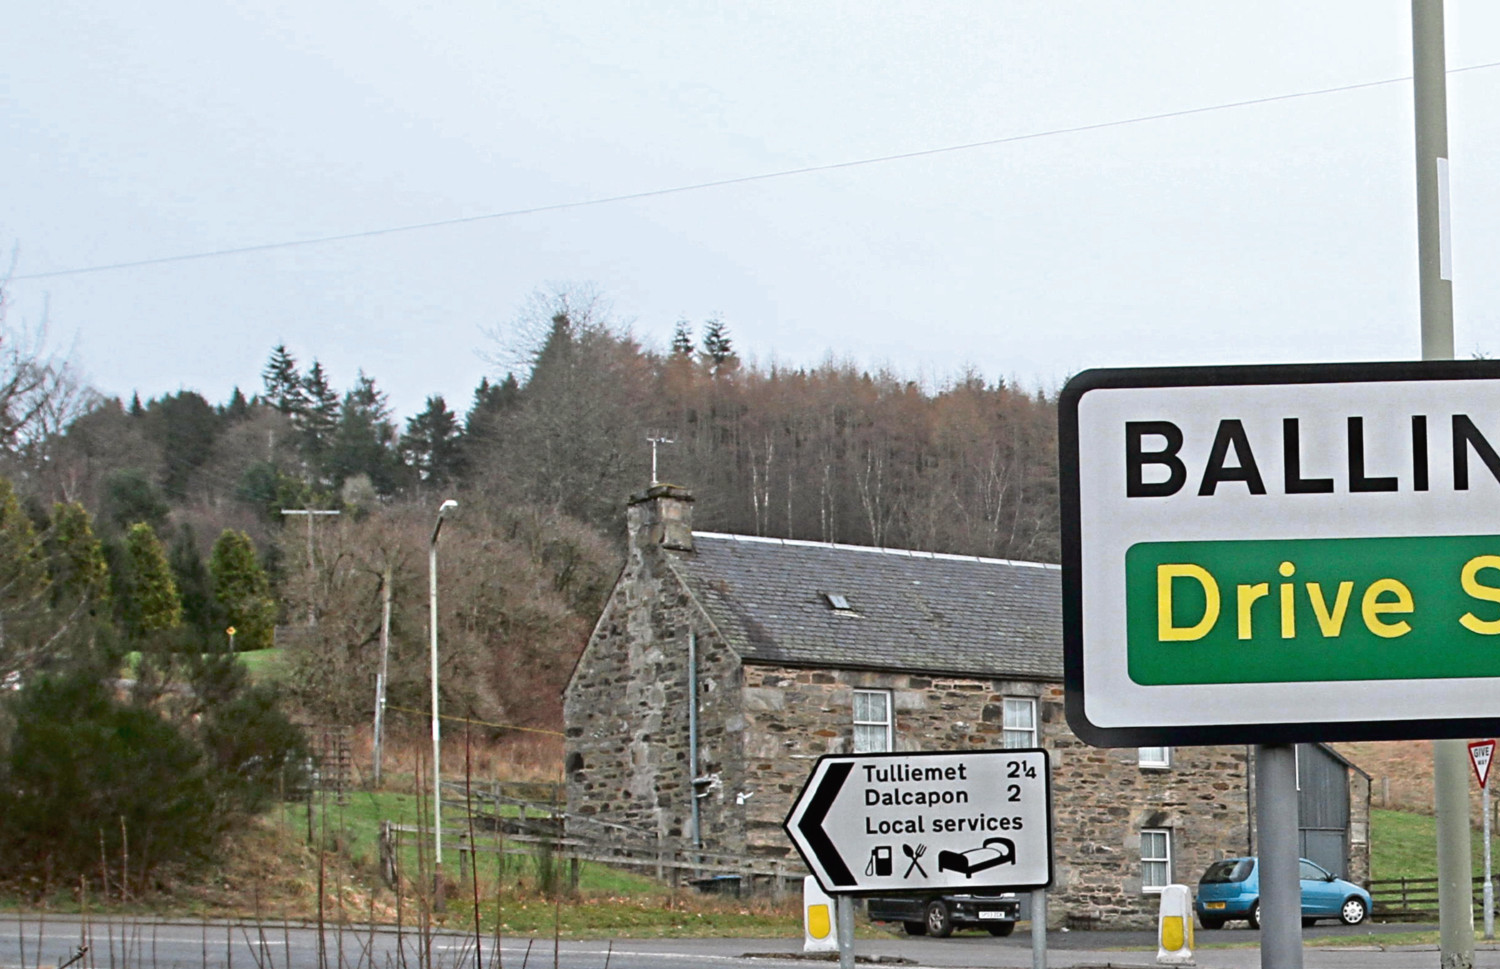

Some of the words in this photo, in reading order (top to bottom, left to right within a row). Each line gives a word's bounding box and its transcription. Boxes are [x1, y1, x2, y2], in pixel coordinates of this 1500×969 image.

[1158, 562, 1413, 641] Drive
[1474, 747, 1490, 758] GIVE
[863, 764, 966, 782] Tulliemet
[866, 788, 968, 807] Dalcapon
[1008, 785, 1020, 801] 2
[866, 816, 924, 834] Local
[933, 814, 1022, 832] services
